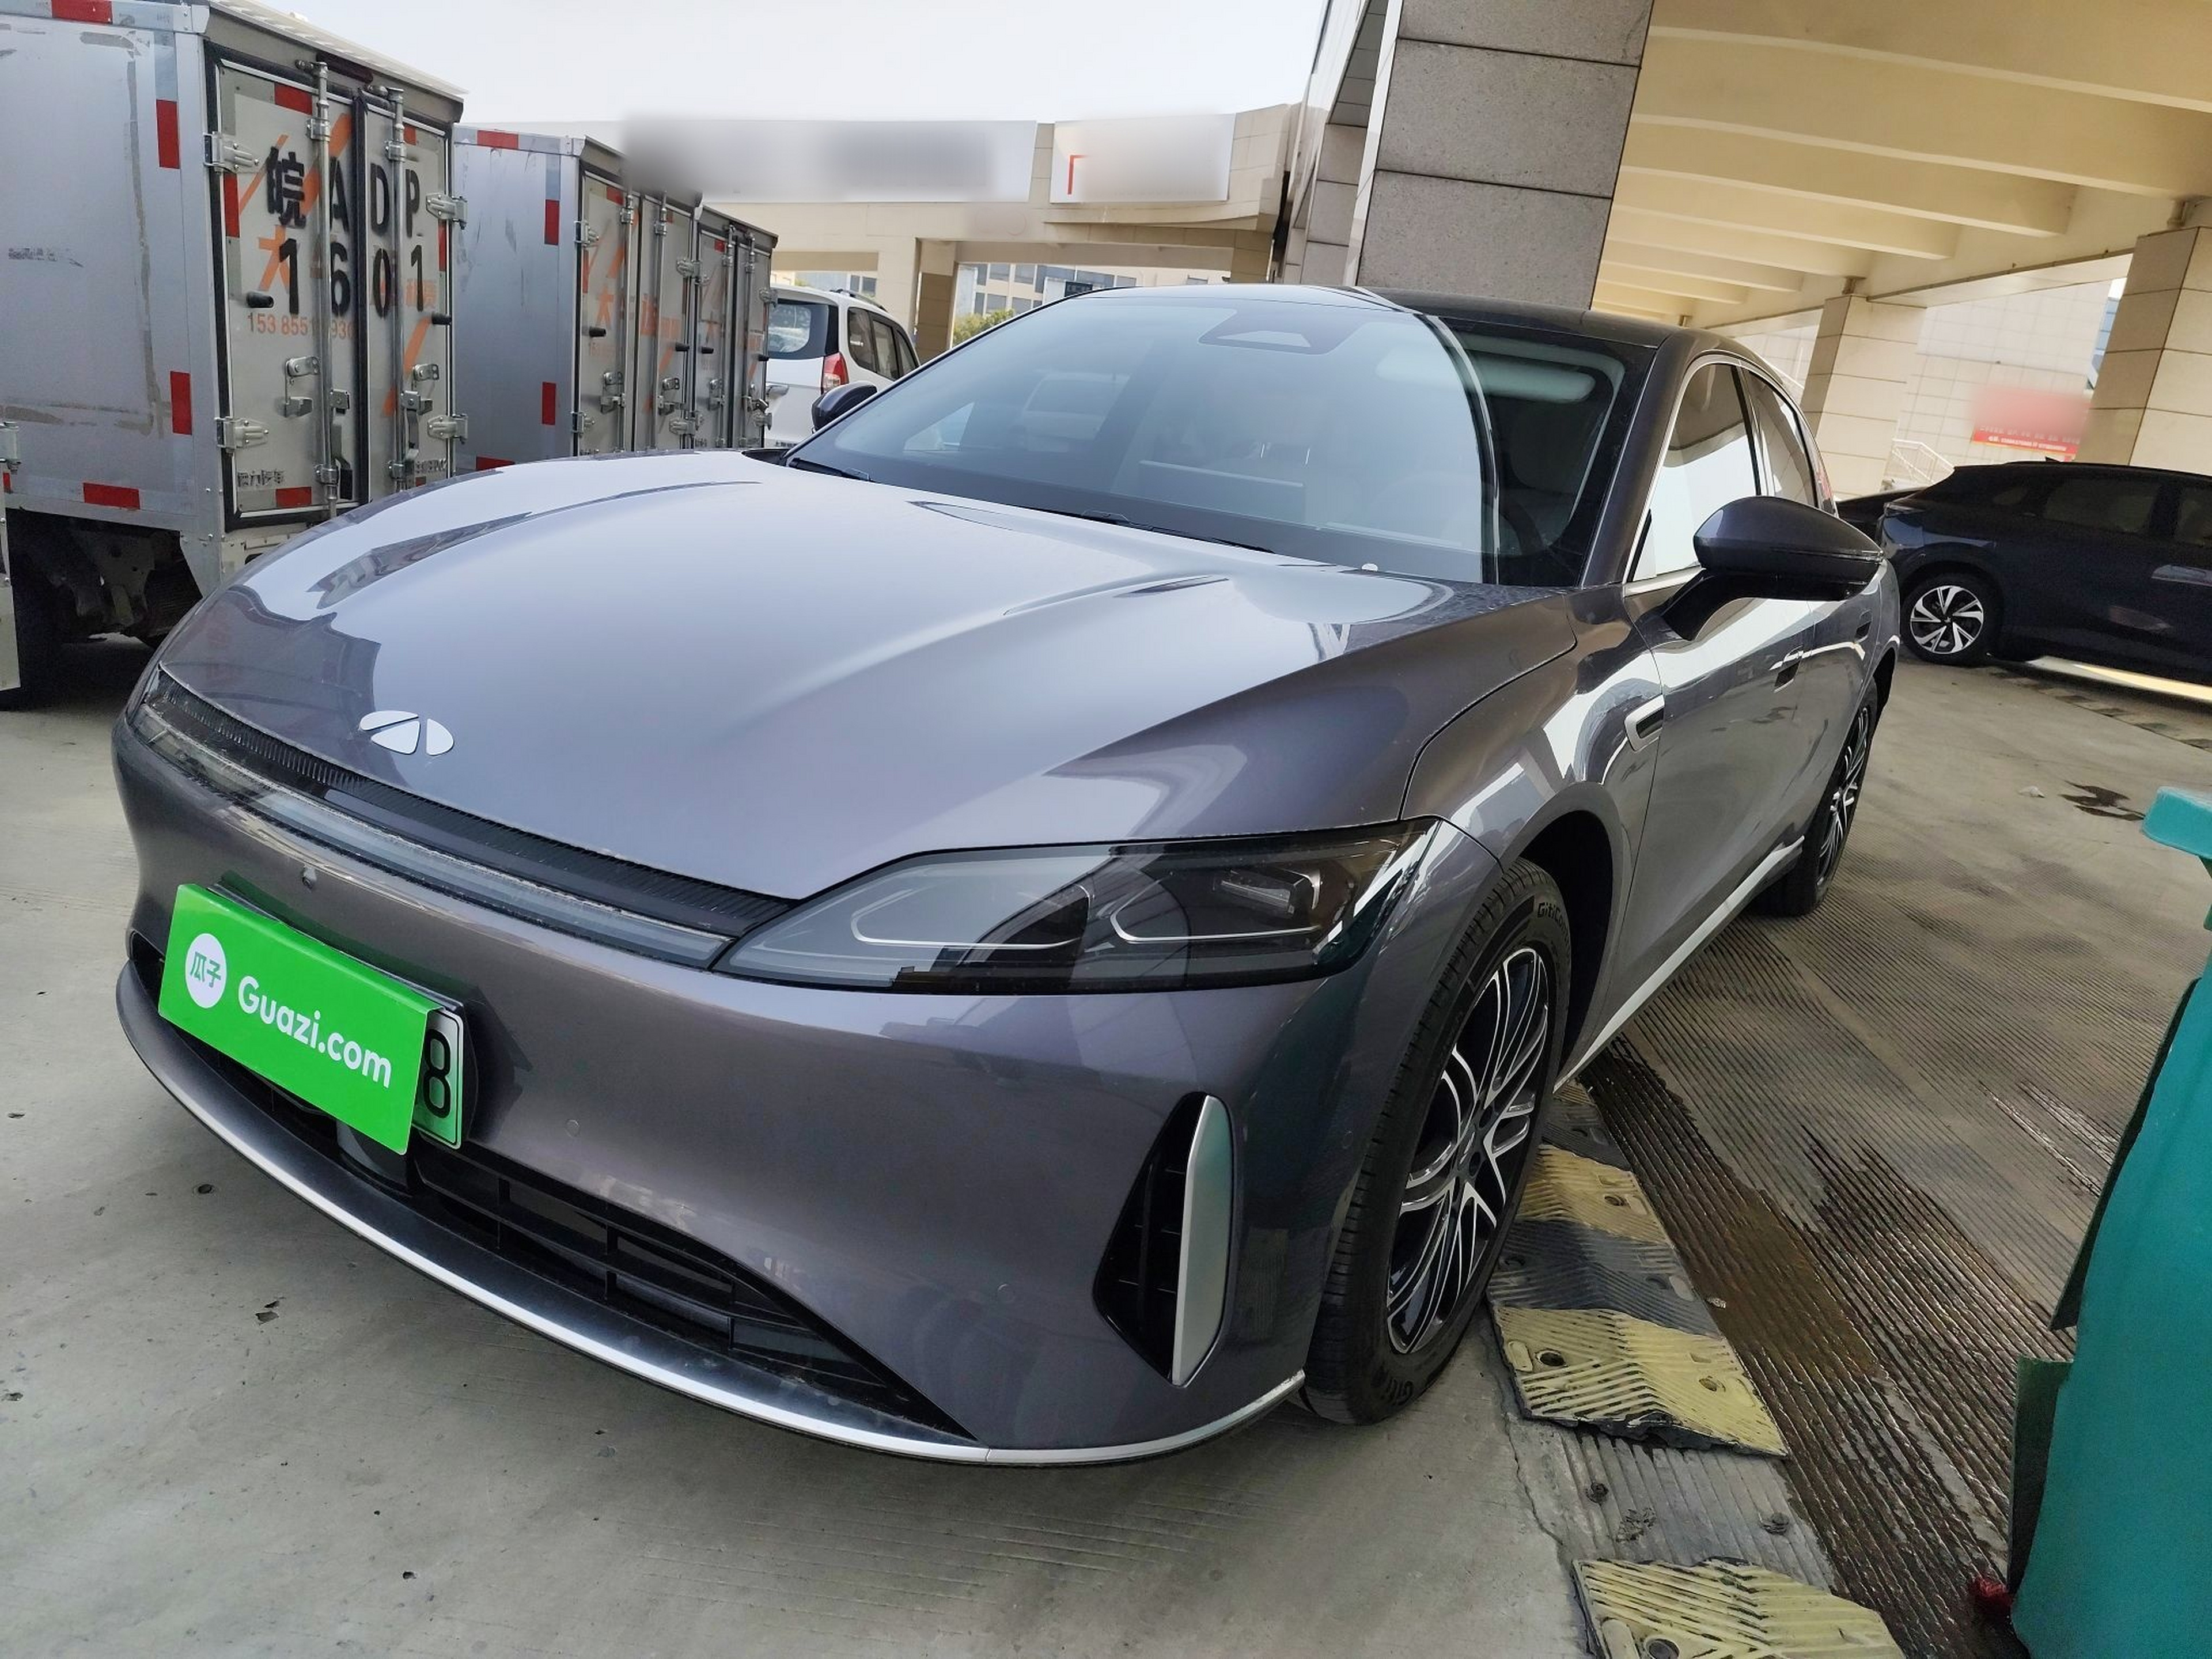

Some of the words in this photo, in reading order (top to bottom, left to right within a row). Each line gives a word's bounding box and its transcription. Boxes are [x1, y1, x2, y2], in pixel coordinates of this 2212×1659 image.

[279, 237, 424, 319] 1601
[190, 951, 221, 988] 瓜子
[238, 975, 392, 1088] Guazi.com
[423, 1029, 451, 1118] 8
